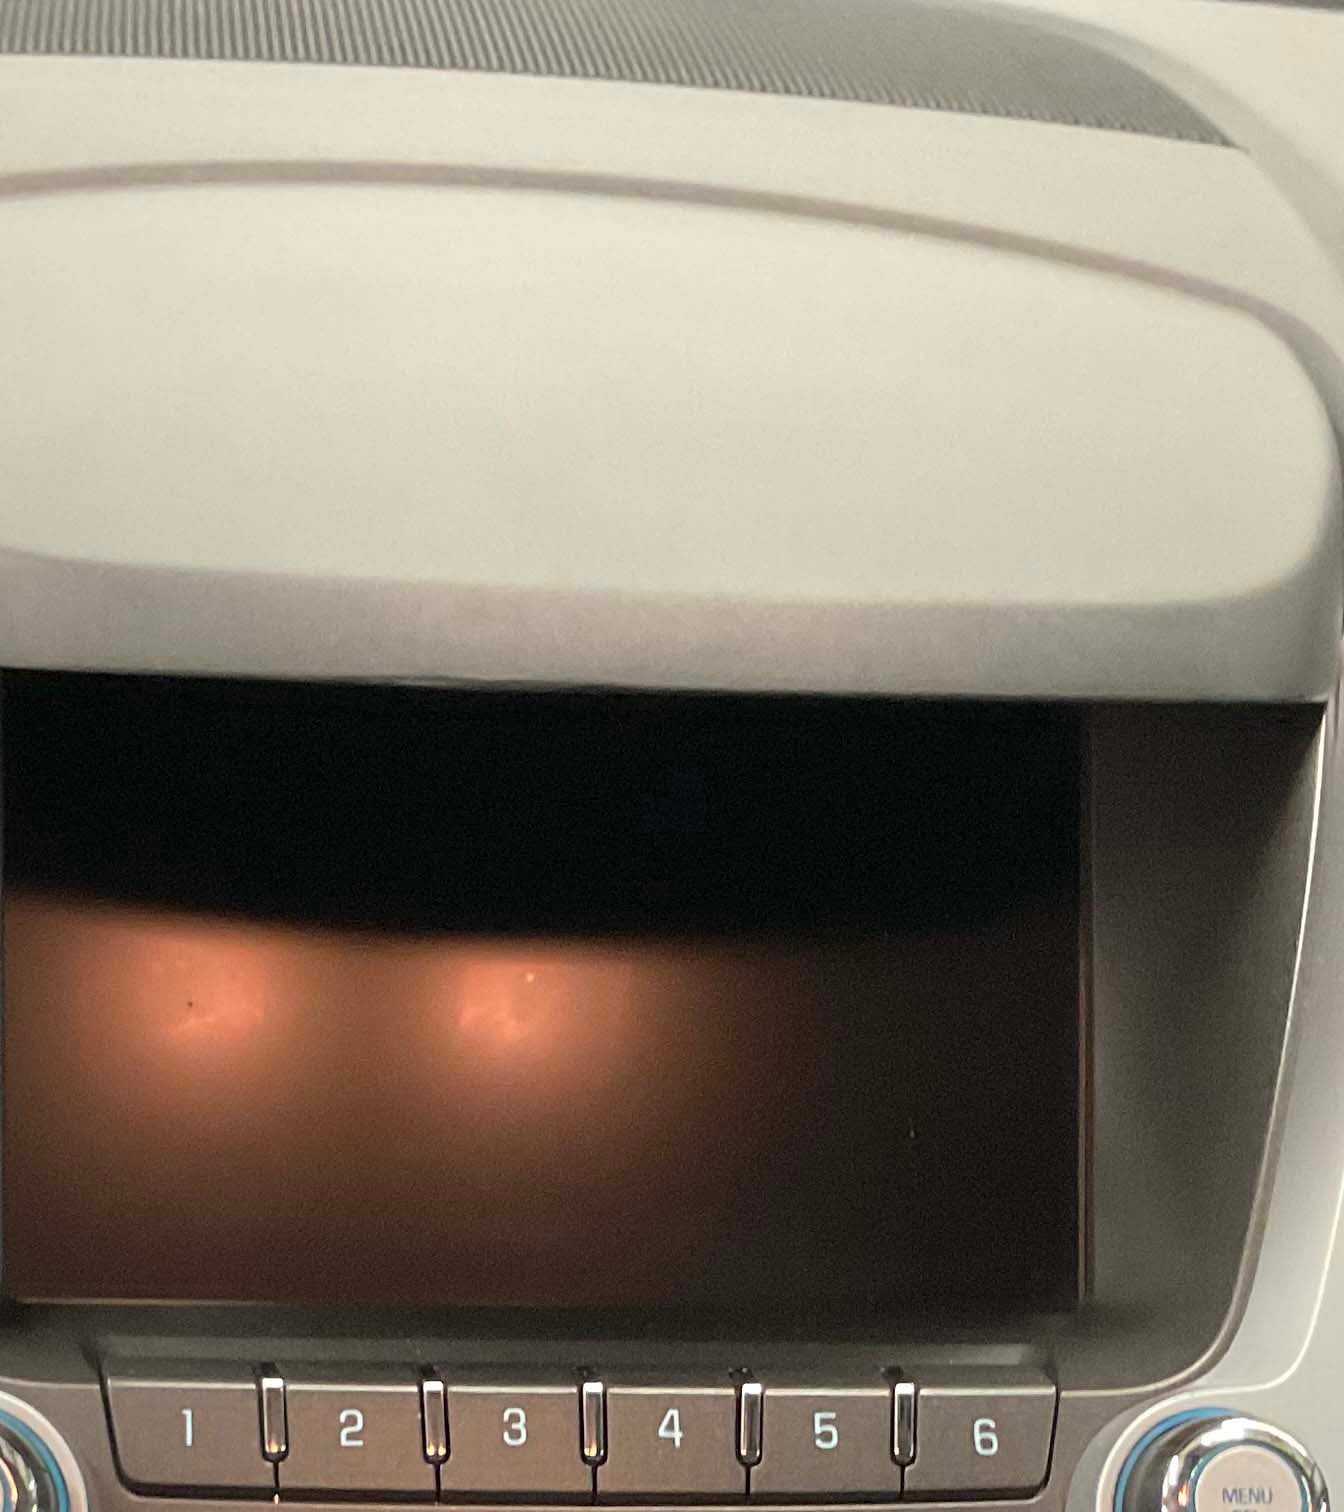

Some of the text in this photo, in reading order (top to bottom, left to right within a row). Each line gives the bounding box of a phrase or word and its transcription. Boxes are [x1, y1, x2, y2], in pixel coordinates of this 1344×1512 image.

[182, 1408, 194, 1447] 1
[338, 1408, 365, 1448] 2
[502, 1407, 528, 1447] 3
[657, 1408, 684, 1449] 4
[813, 1411, 840, 1451] 5
[972, 1418, 1000, 1456] 6
[1221, 1487, 1274, 1505] MENU
